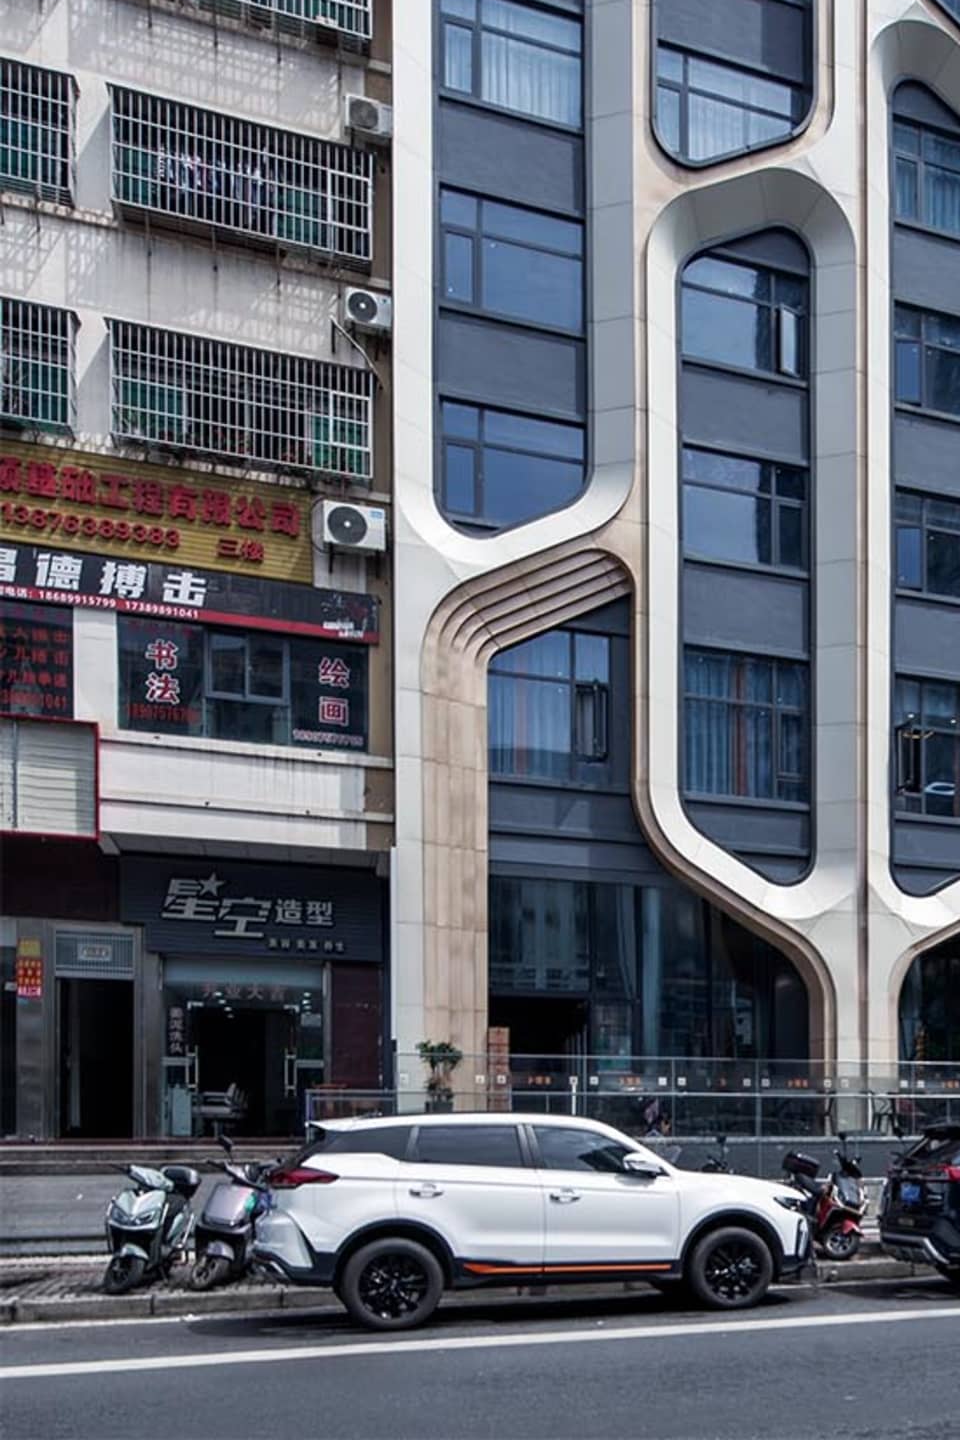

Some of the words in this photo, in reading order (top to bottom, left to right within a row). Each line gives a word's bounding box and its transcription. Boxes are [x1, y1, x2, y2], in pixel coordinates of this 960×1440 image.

[217, 537, 264, 562] 三楼
[38, 589, 117, 608] 18689915799
[145, 638, 181, 705] 书法
[319, 656, 351, 726] 绘画
[161, 871, 334, 939] 星空造型
